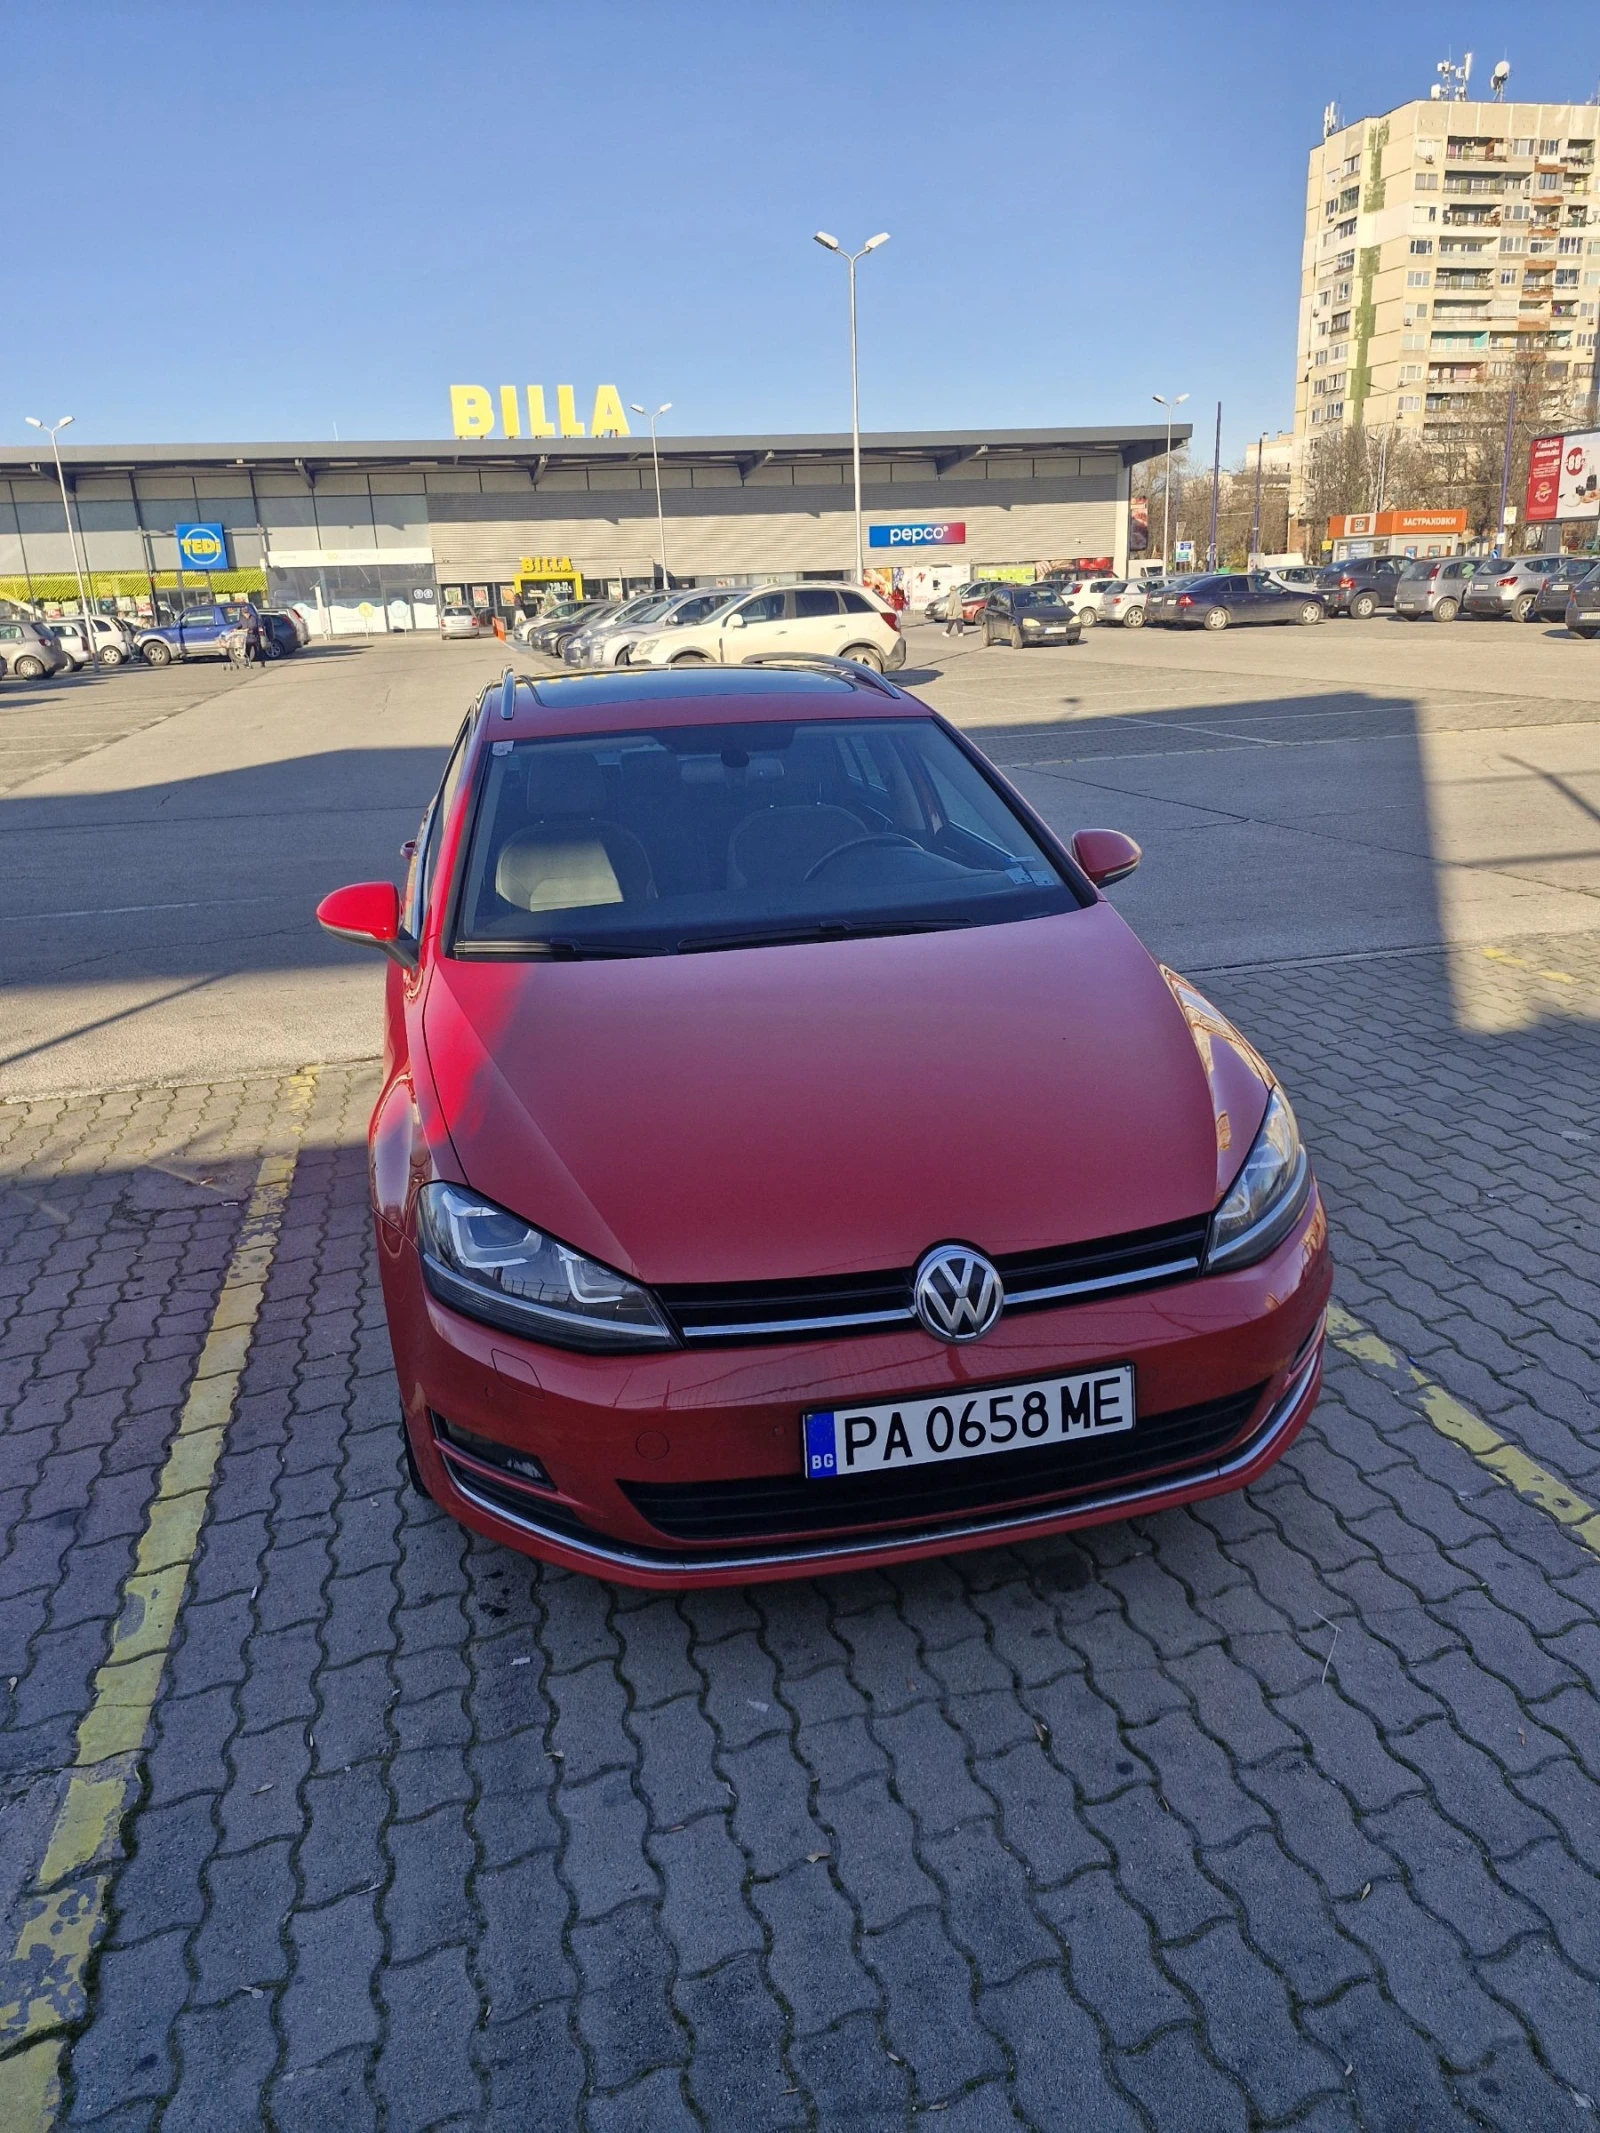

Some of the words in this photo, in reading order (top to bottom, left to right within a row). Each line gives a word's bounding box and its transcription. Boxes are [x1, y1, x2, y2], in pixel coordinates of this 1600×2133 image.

[450, 384, 631, 437] BILLA
[1402, 516, 1457, 527] ЗАСТРАХОВКИ
[889, 526, 949, 545] pepco
[181, 538, 221, 555] TEDi
[521, 556, 573, 573] BILLA
[844, 1411, 914, 1467] PA
[925, 1390, 1050, 1453] 0658
[1060, 1375, 1124, 1434] ME
[810, 1453, 835, 1471] BG
